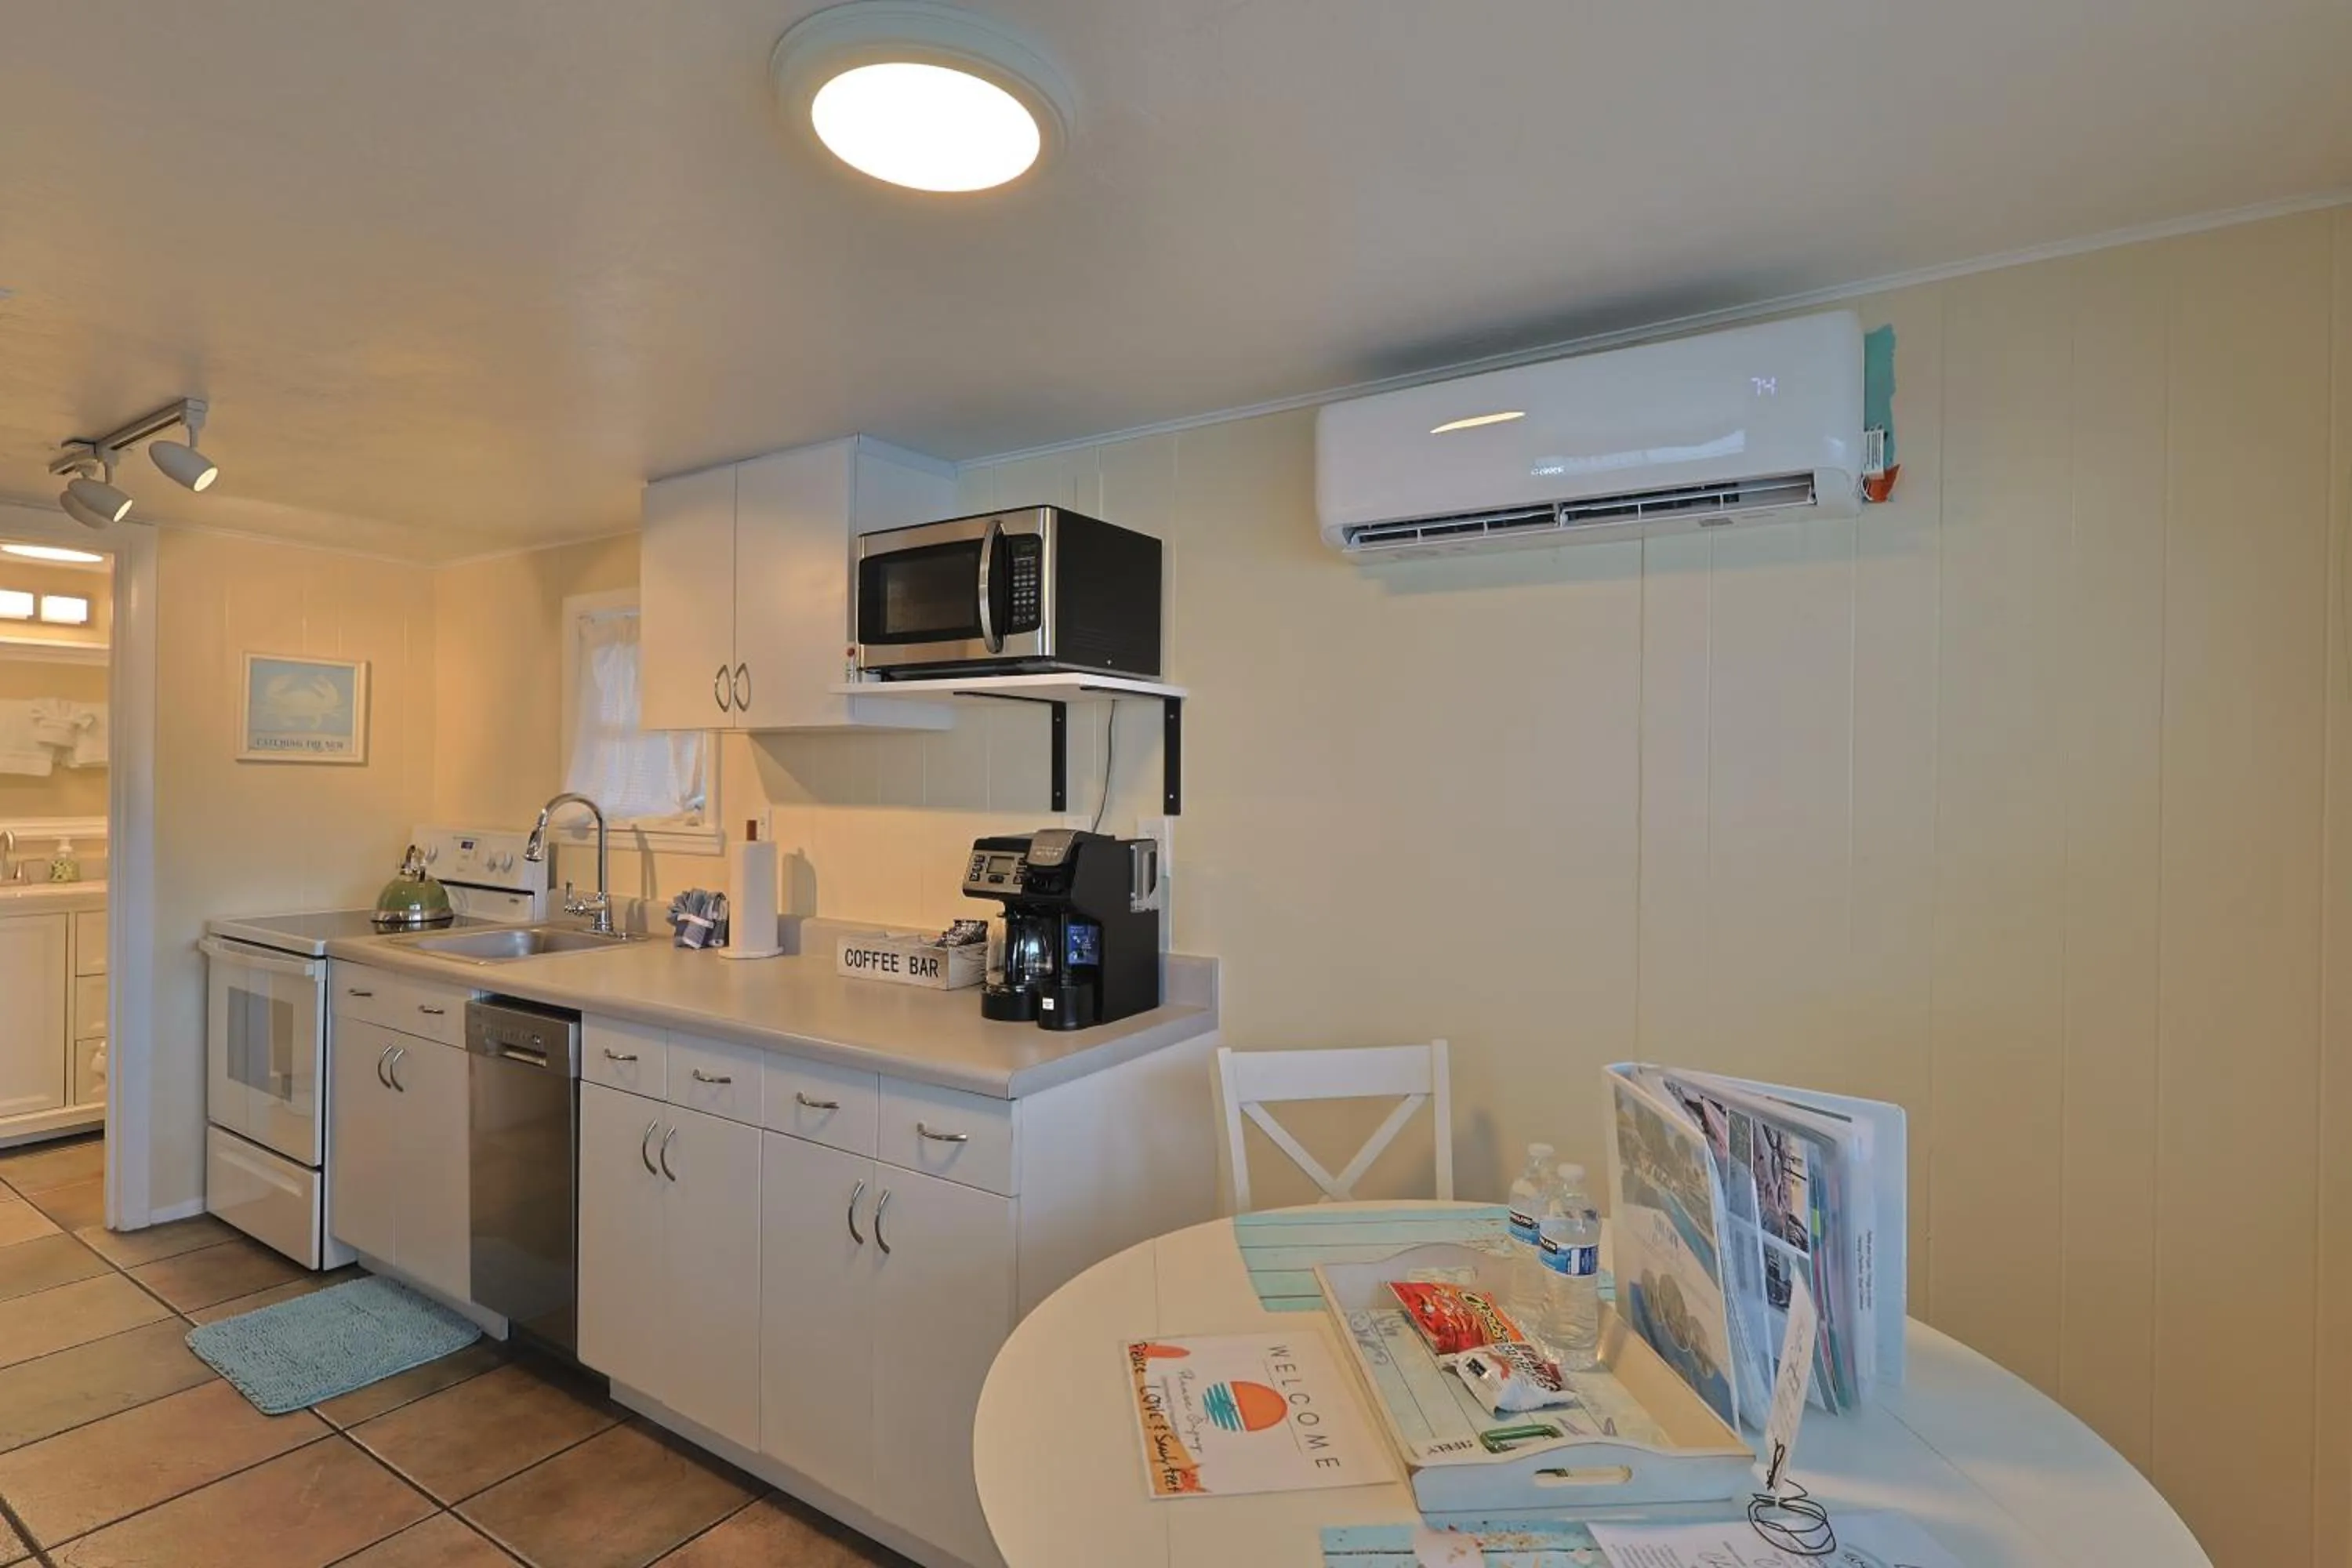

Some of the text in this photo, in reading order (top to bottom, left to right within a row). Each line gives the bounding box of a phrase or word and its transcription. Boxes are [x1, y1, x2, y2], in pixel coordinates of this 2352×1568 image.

[1750, 376, 1776, 397] 74
[845, 948, 938, 978] COFFEE BAR
[1268, 1345, 1341, 1468] WELCOME
